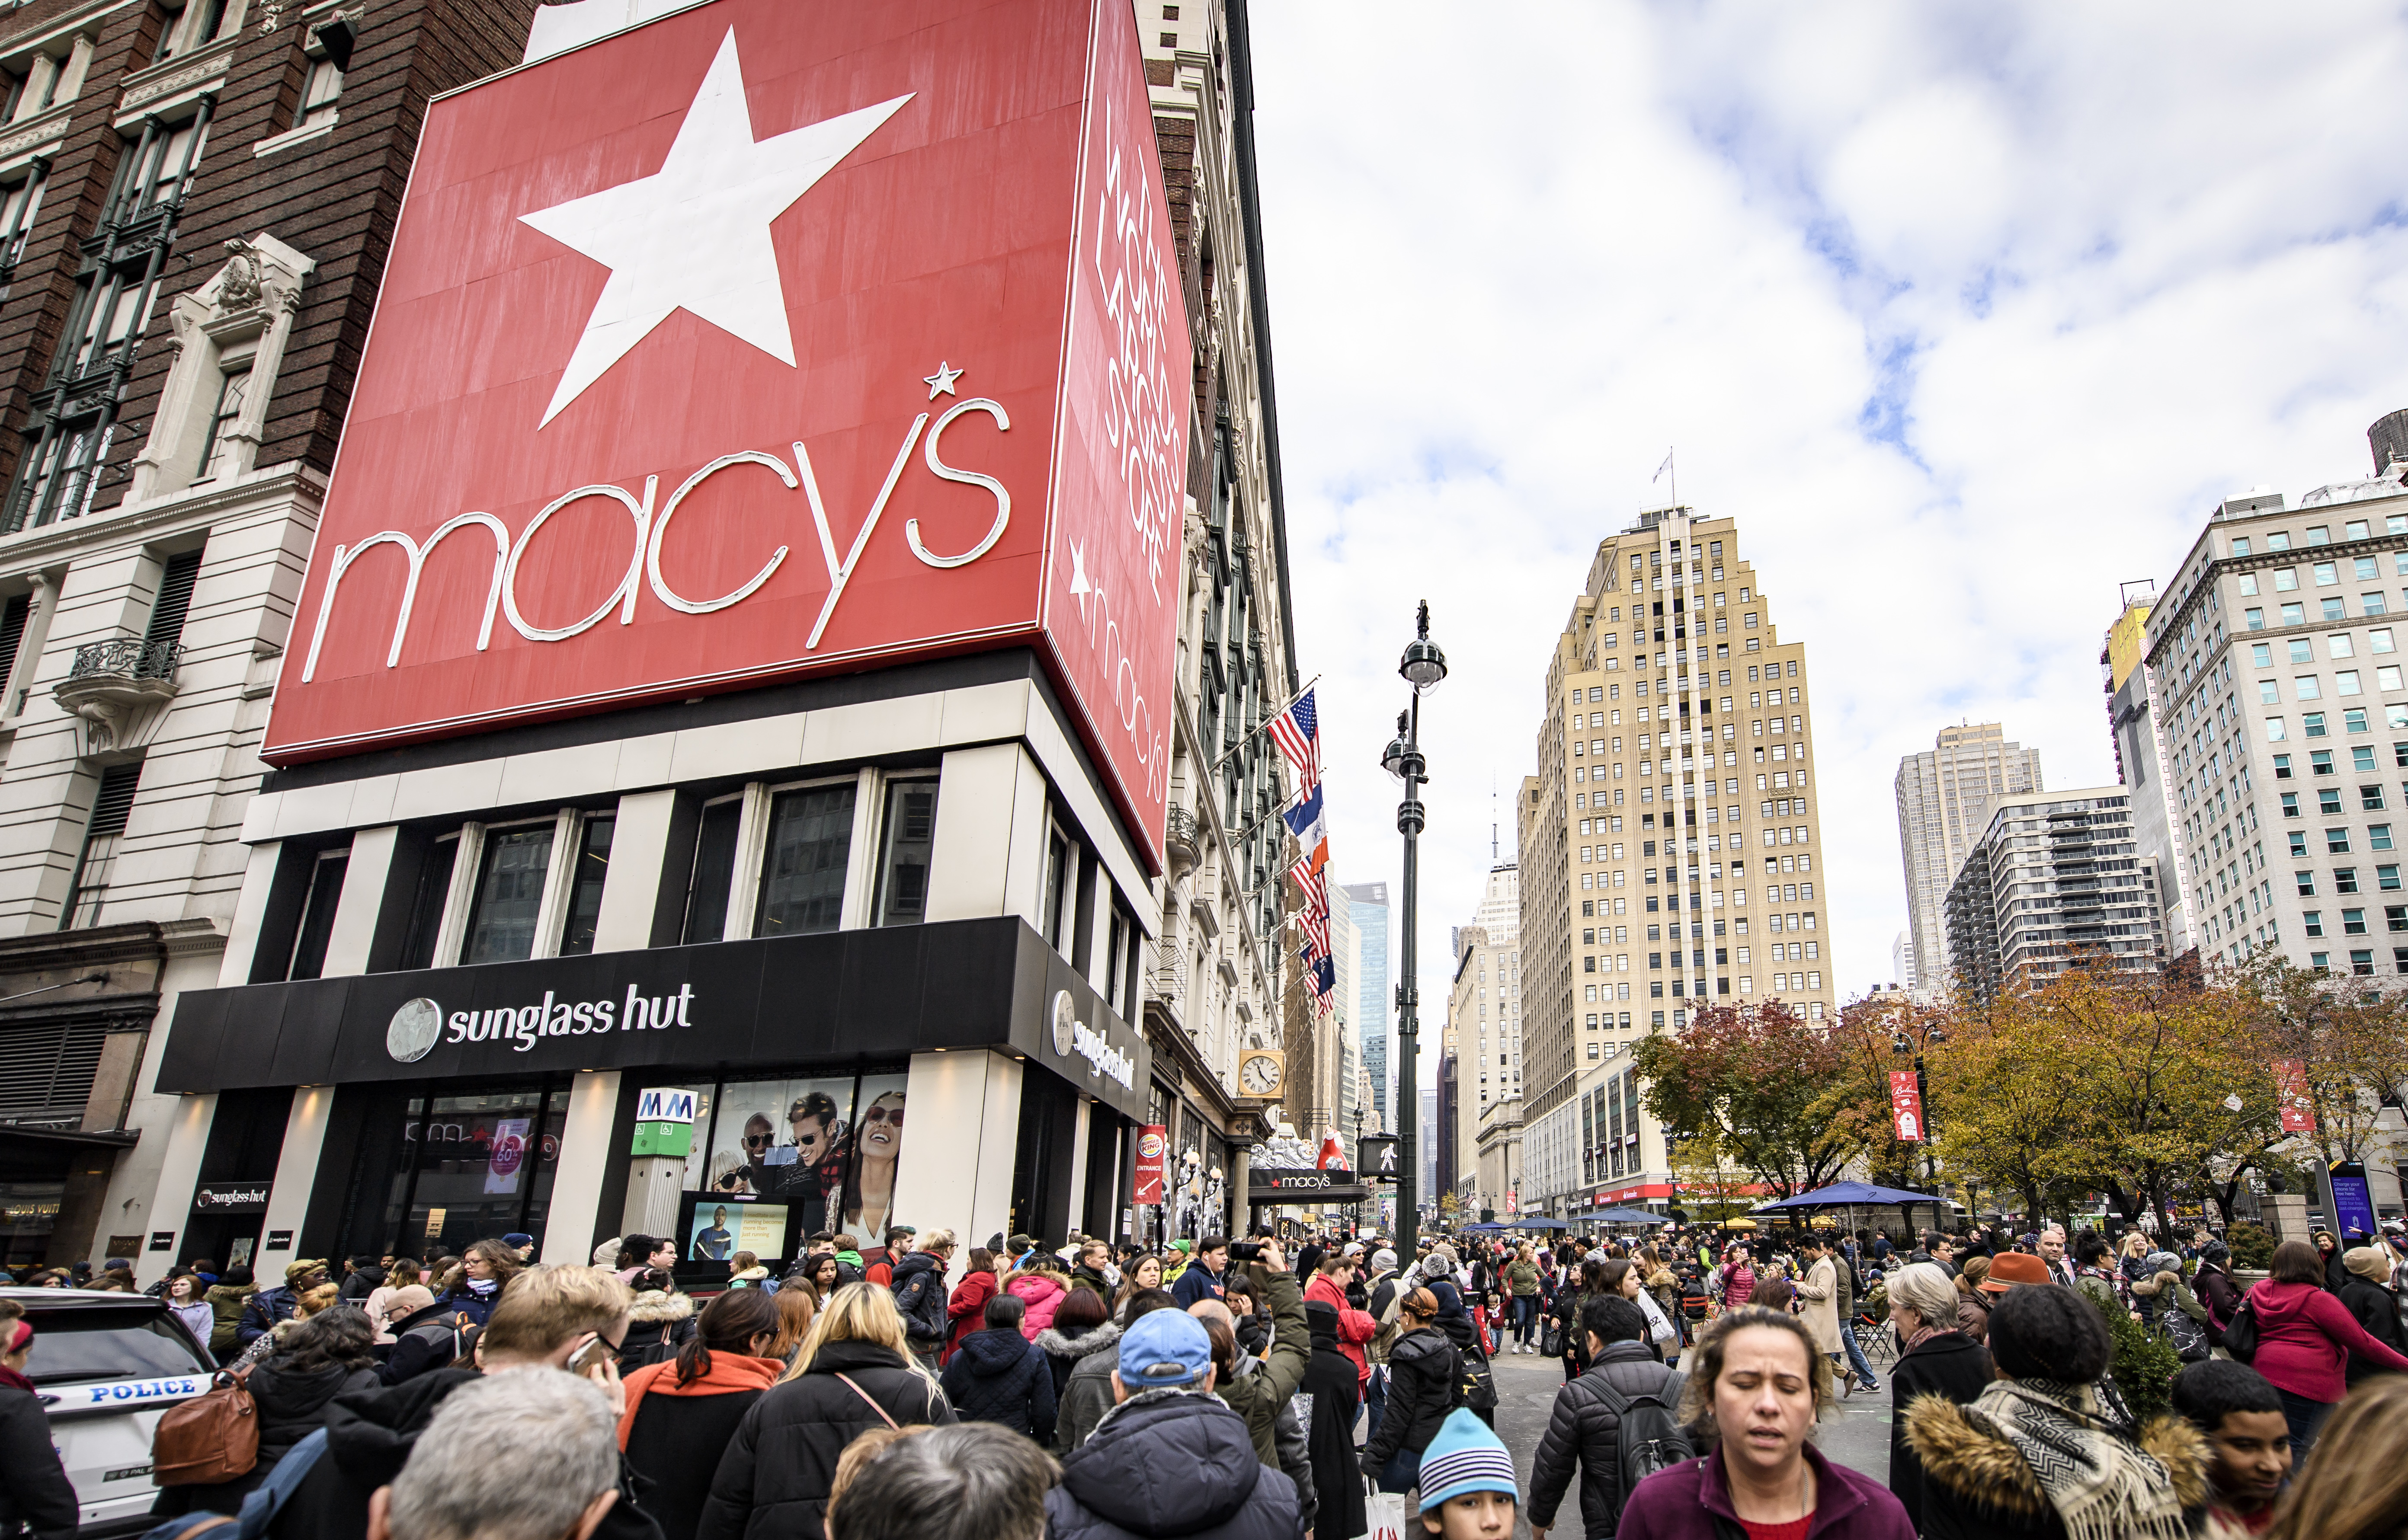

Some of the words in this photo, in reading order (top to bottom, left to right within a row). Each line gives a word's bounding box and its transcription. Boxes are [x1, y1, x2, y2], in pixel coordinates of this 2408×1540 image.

[1105, 357, 1164, 608] STORE
[447, 991, 615, 1051] sunglass
[621, 984, 695, 1030] hut
[1072, 1021, 1119, 1077] sunglass
[1118, 1046, 1134, 1091] hut
[1892, 1084, 1918, 1096] Believe
[1142, 1143, 1160, 1152] KING
[211, 1189, 250, 1206] sunglass
[249, 1189, 266, 1202] hut
[90, 1379, 195, 1402] POLICE
